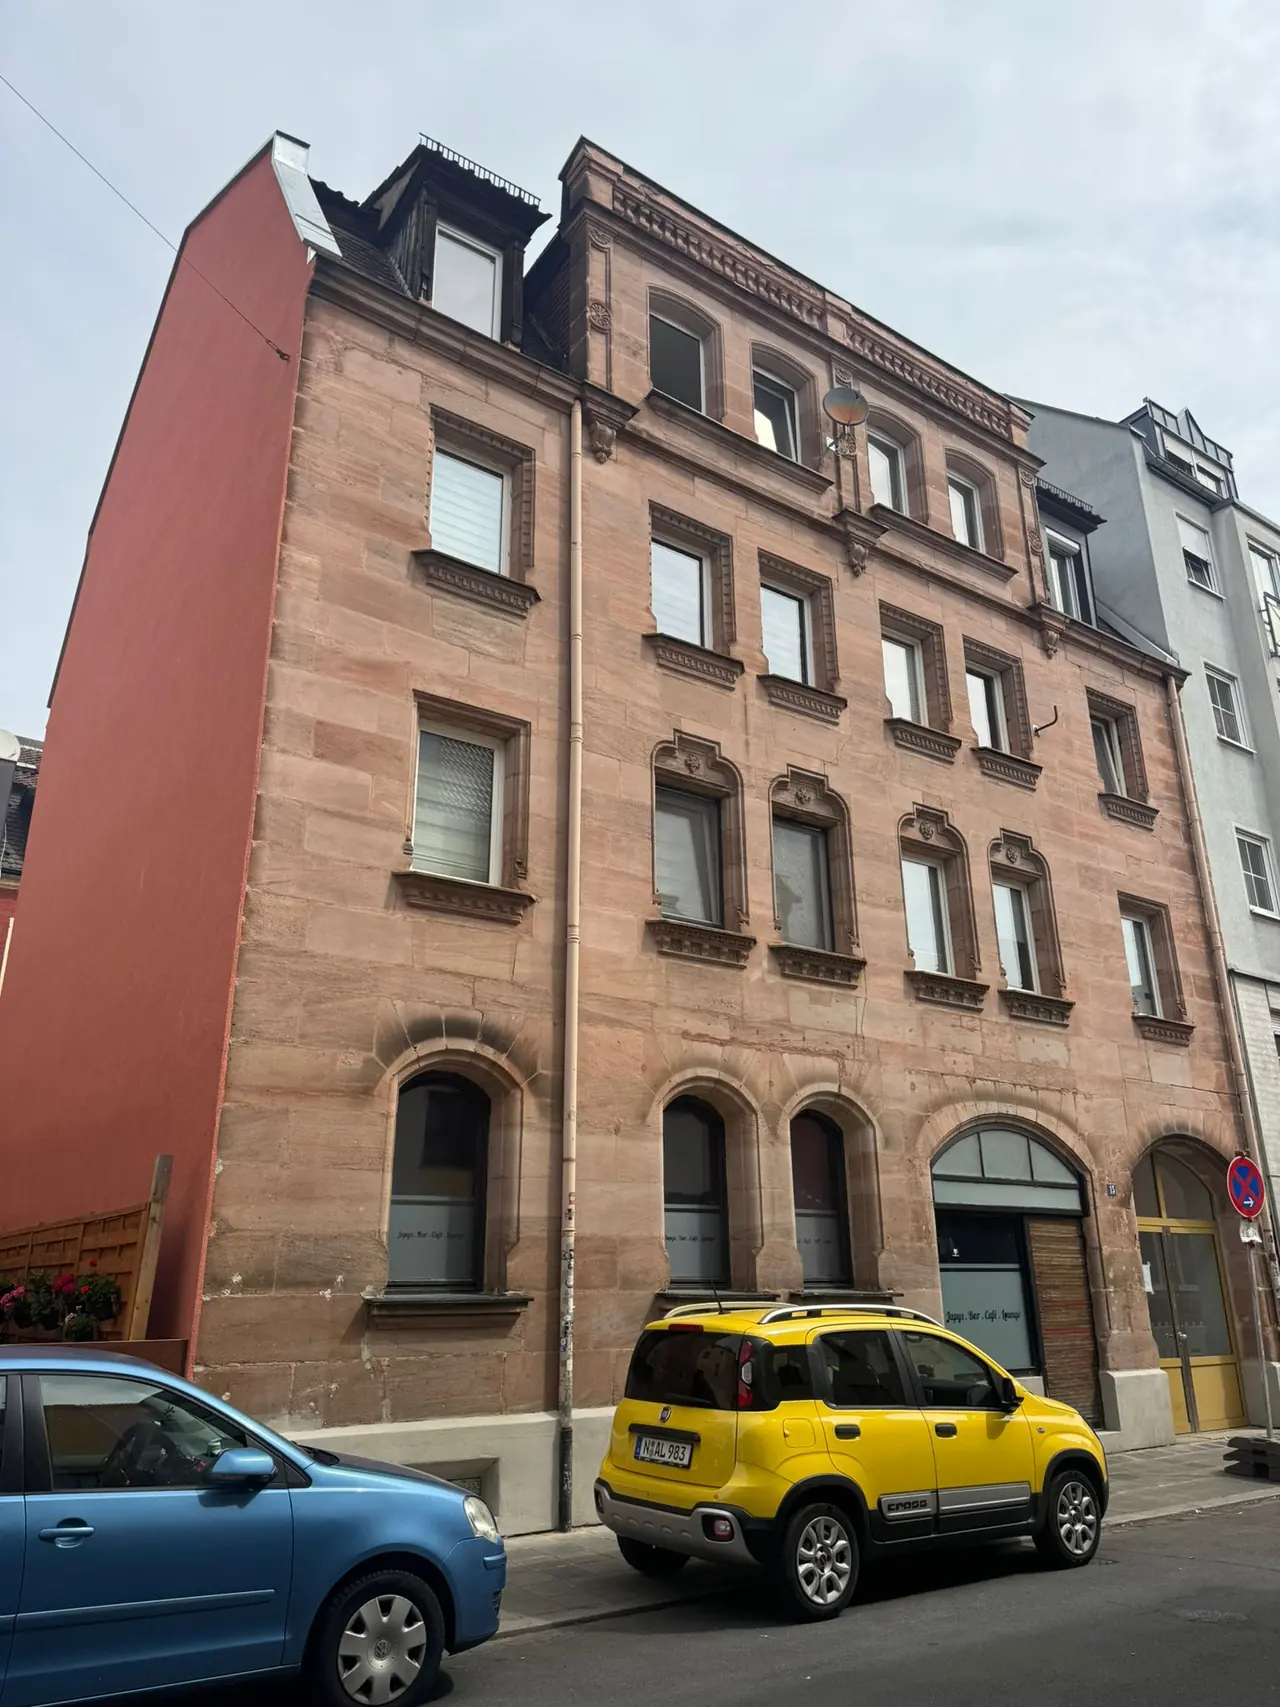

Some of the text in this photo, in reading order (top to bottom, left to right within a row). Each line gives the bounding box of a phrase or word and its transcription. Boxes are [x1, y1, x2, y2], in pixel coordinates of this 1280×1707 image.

[643, 1439, 686, 1462] N AL 983
